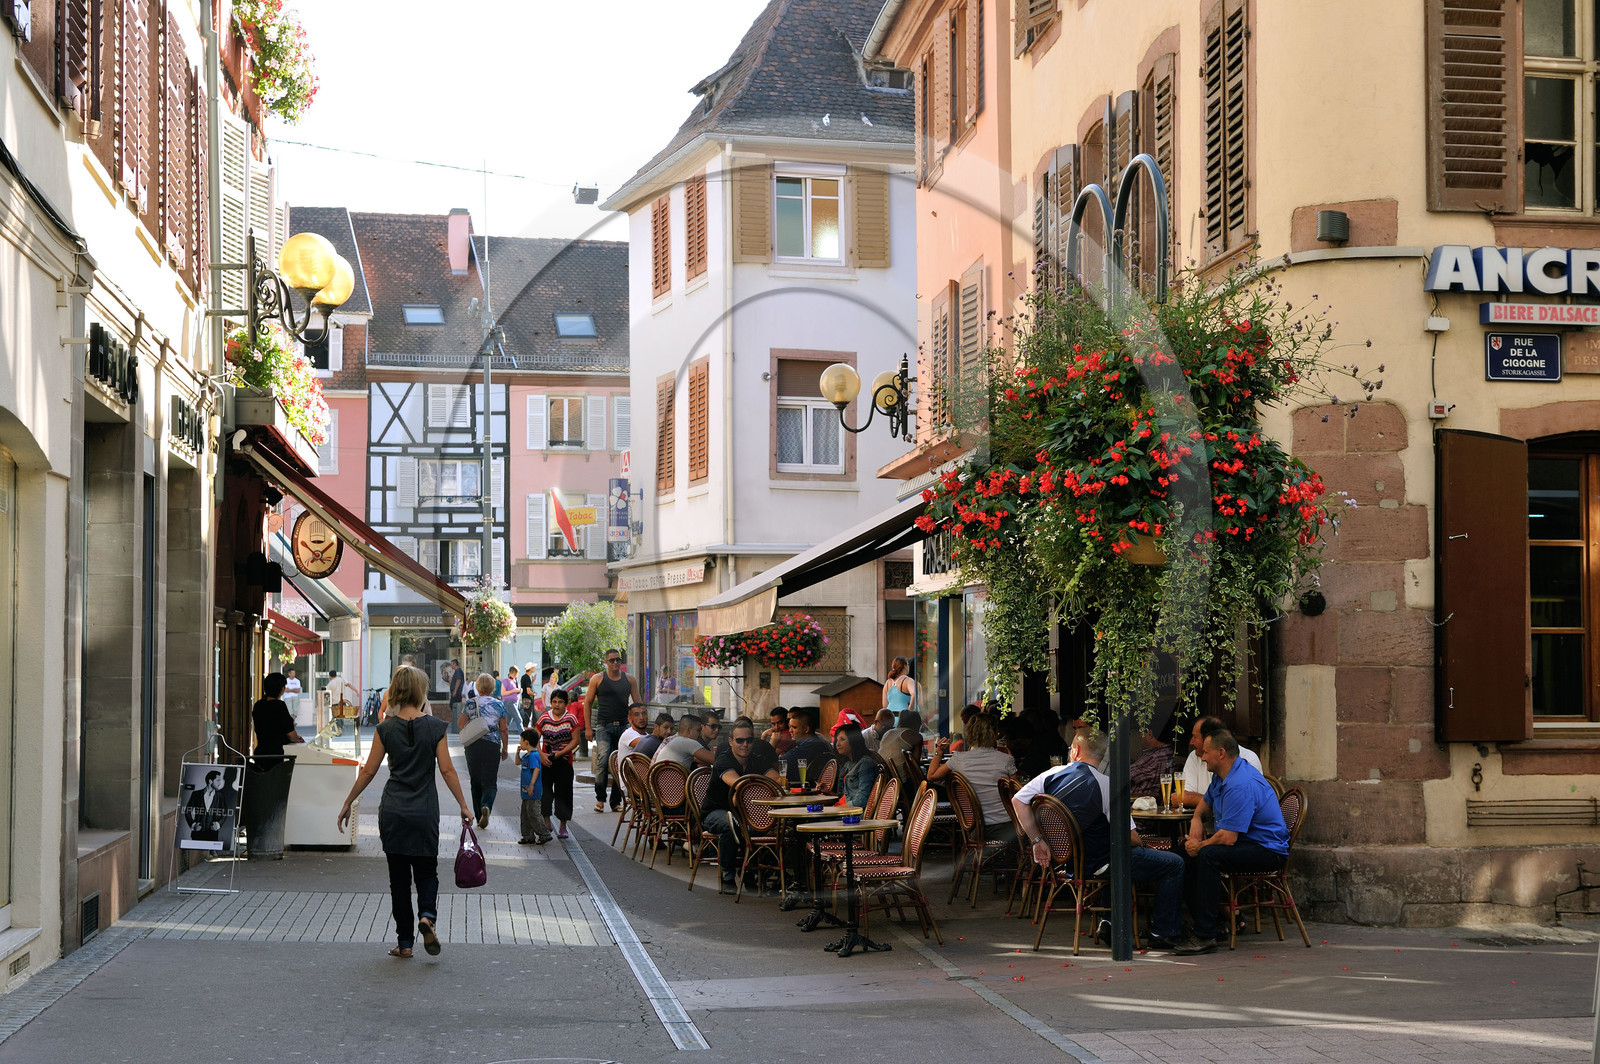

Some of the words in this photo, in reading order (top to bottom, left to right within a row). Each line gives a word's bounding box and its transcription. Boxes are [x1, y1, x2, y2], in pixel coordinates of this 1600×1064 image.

[1494, 305, 1534, 321] BIERE
[1539, 307, 1599, 323] D'ALSACE
[1514, 338, 1534, 347] RUE
[1510, 349, 1525, 357] DE
[1525, 349, 1538, 358] LA
[1502, 358, 1546, 368] CIGOGNE
[1574, 355, 1599, 367] DES
[1501, 369, 1547, 377] STORIKAGASSEL
[568, 511, 593, 521] Tabac
[392, 615, 443, 625] COIFFURE
[181, 806, 235, 817] LAGERFELD
